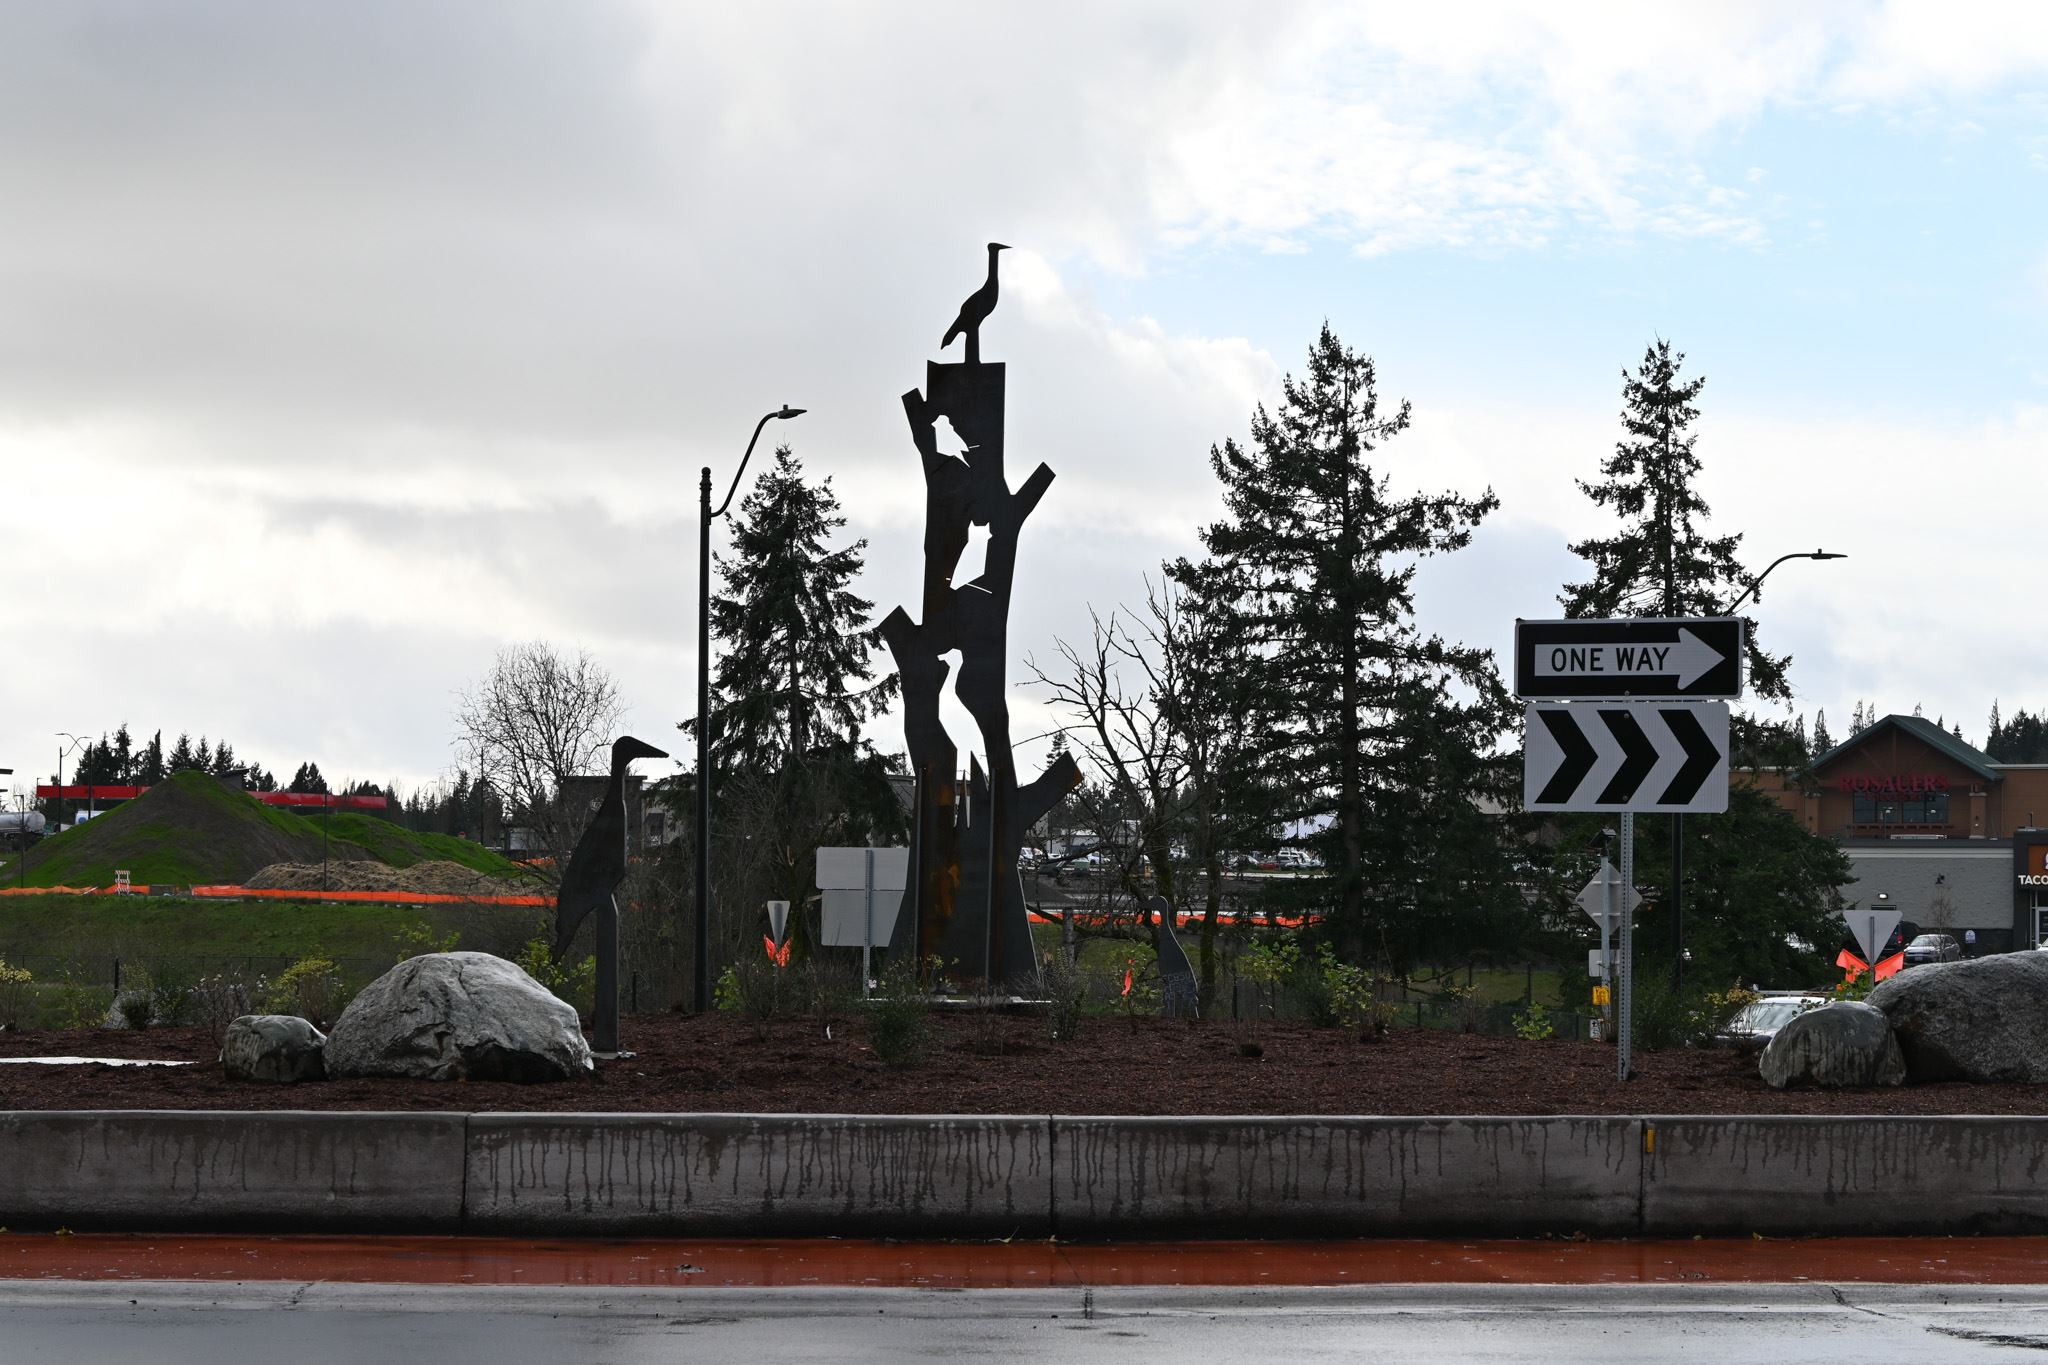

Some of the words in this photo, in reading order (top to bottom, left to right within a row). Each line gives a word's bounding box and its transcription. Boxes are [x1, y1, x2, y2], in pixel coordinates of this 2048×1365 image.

[1551, 648, 1604, 672] ONE
[1616, 647, 1670, 671] WAY
[1839, 773, 1951, 792] ROSAUERS
[2017, 875, 2048, 885] TACO
